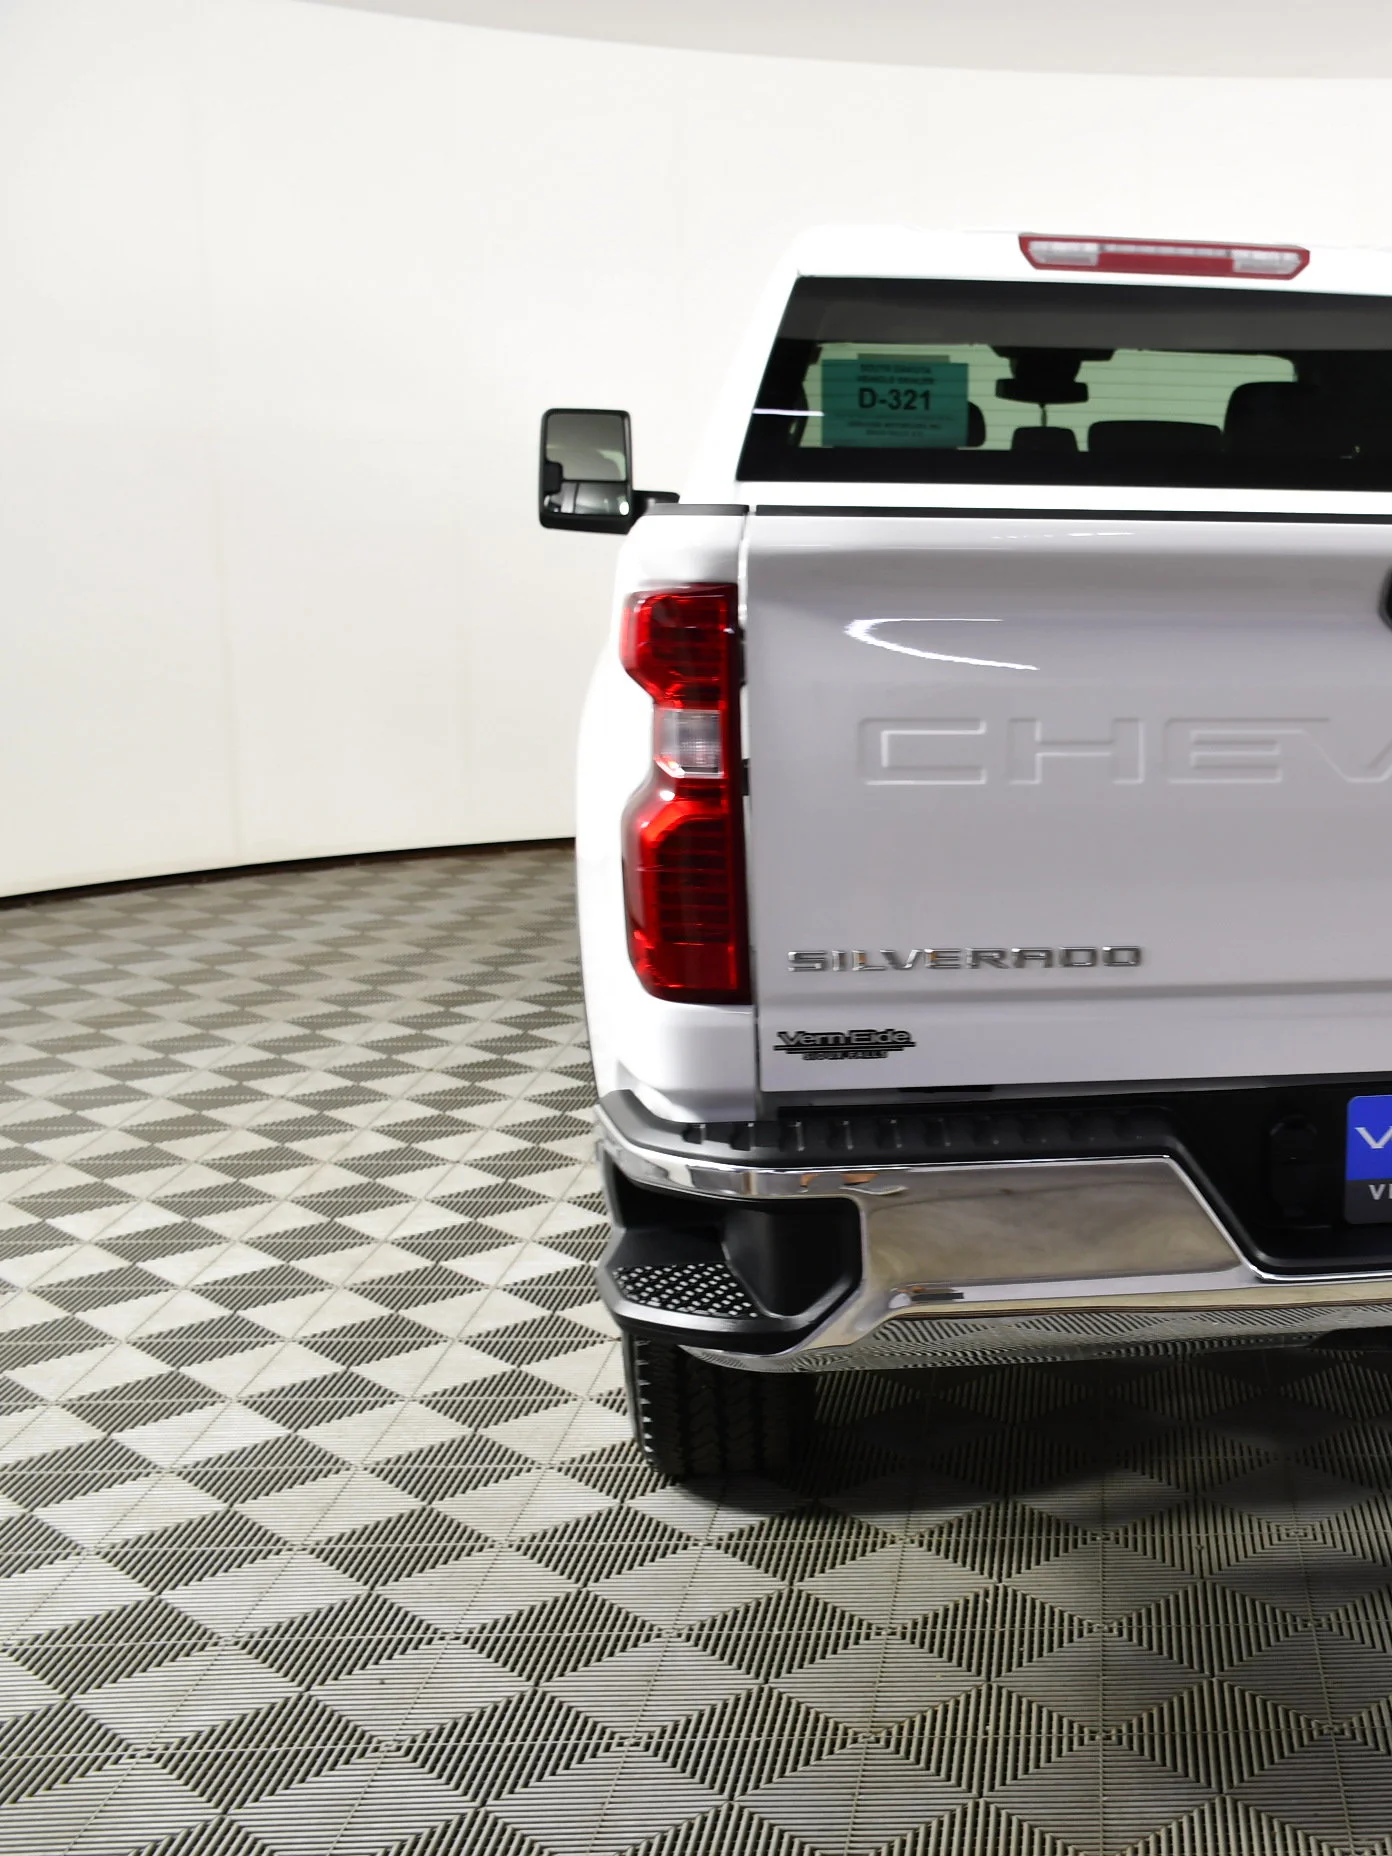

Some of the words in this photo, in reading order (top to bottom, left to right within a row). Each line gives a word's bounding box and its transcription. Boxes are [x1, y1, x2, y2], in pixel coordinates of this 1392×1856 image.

[858, 387, 932, 411] D-321
[787, 945, 1143, 973] SILVERADO
[777, 1031, 845, 1046] Vern
[847, 1029, 913, 1044] Eide
